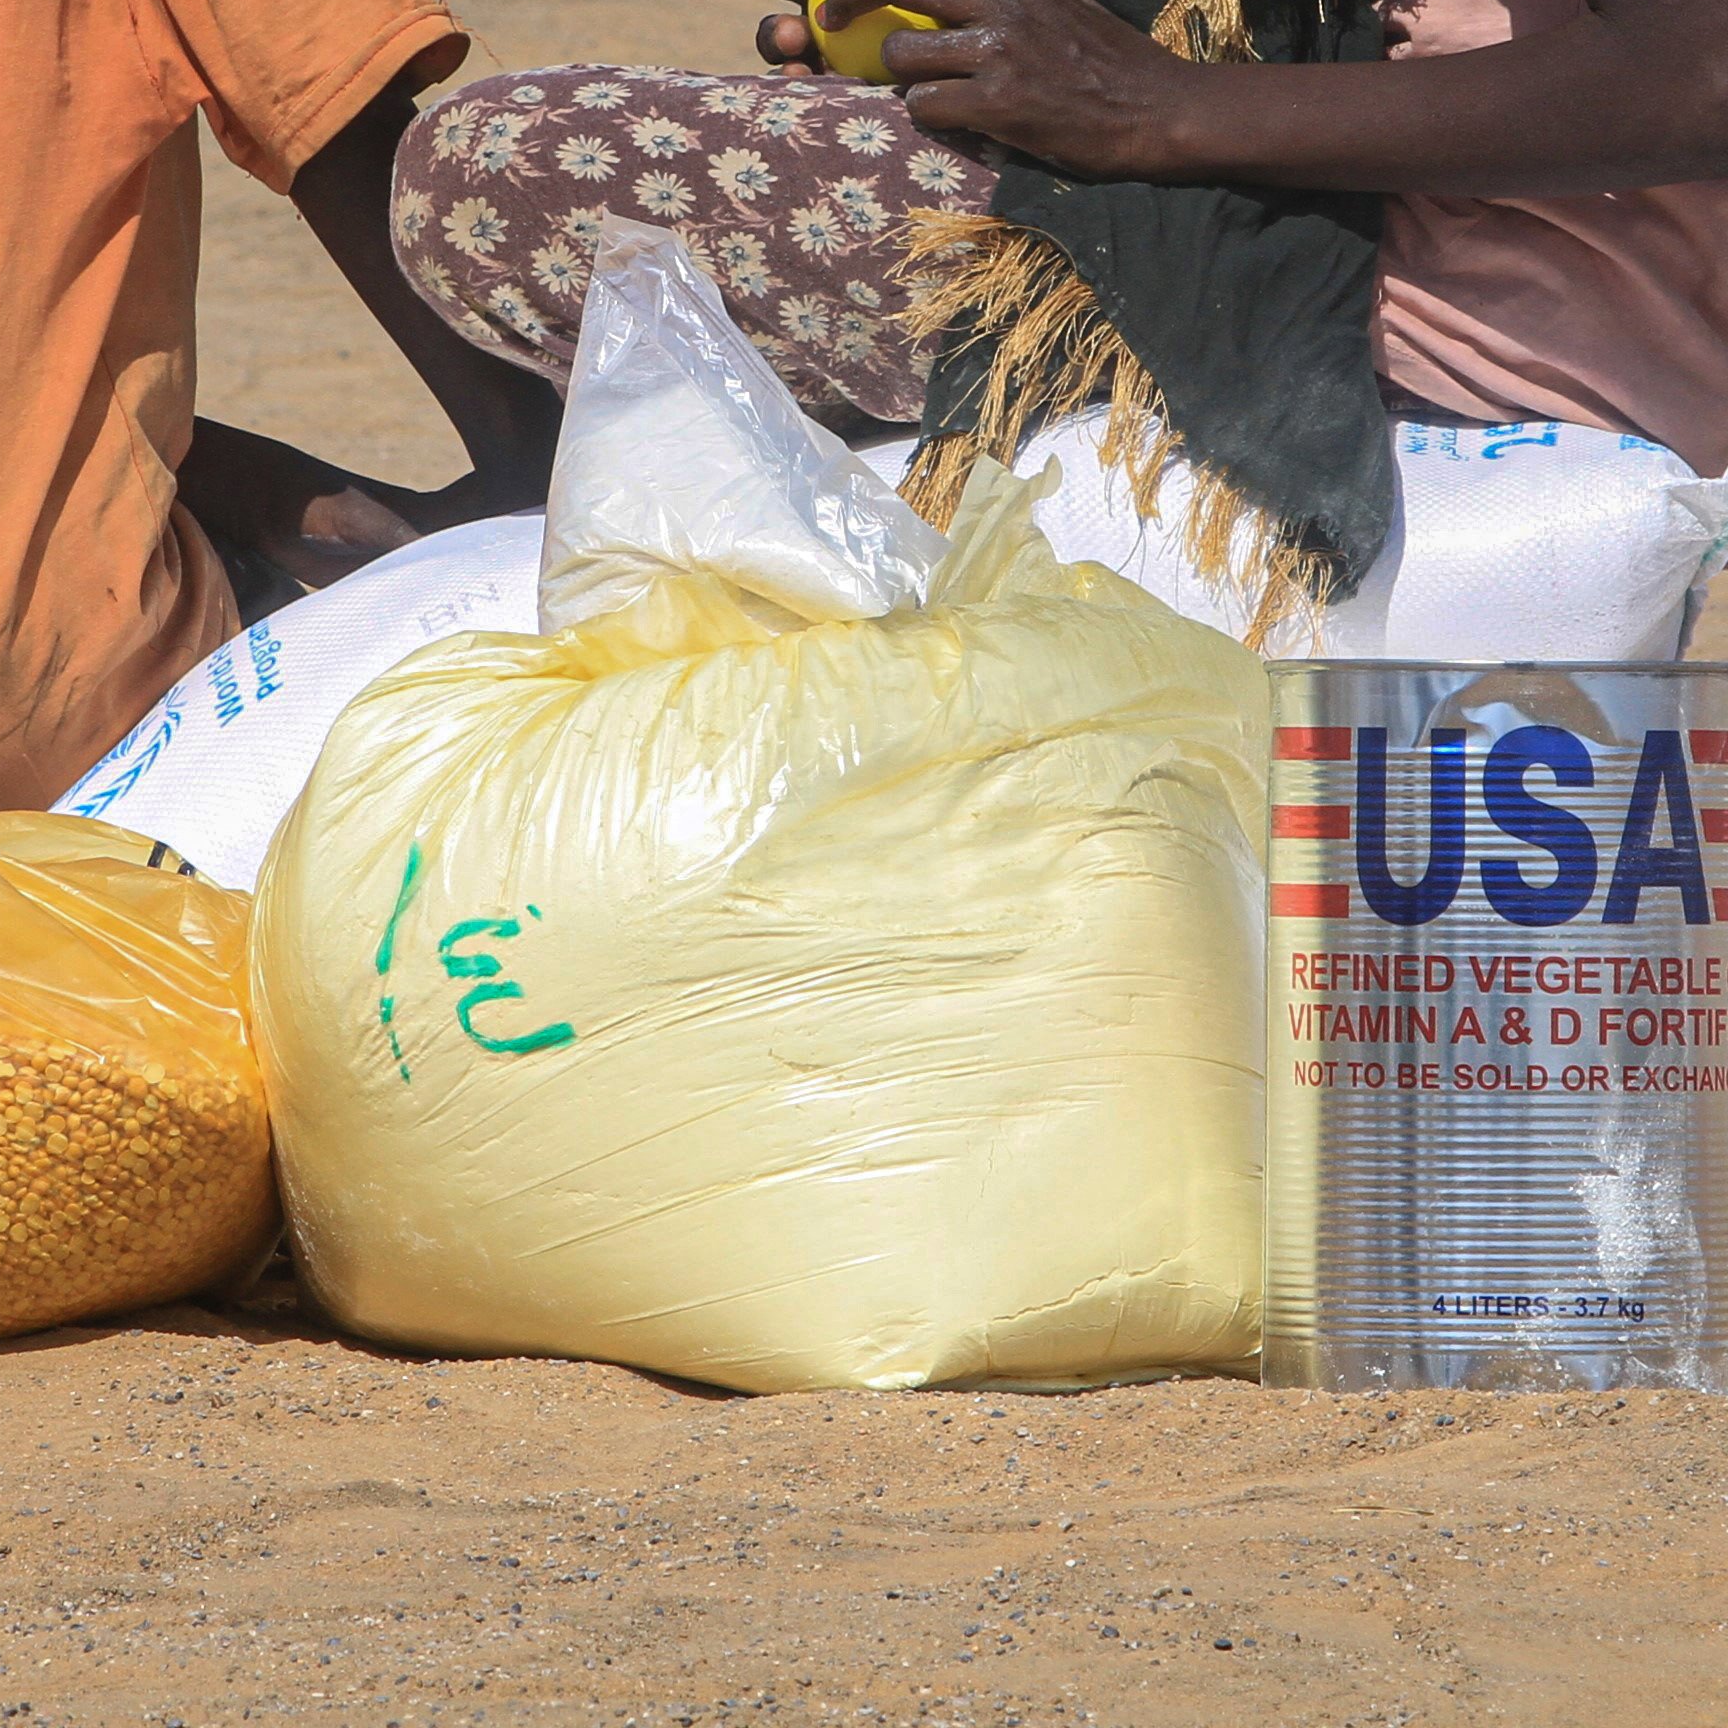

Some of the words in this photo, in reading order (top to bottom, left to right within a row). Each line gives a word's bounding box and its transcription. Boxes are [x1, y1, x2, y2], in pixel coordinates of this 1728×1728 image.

[206, 656, 244, 728] World
[1356, 725, 1711, 927] USA
[1291, 952, 1455, 993] REFINED
[1469, 955, 1721, 996] VEGETABLE
[1288, 1003, 1437, 1044] VITAMIN
[1450, 1006, 1486, 1045] A
[1499, 1006, 1533, 1046] &
[1550, 1007, 1581, 1046] D
[1294, 1060, 1338, 1088] NOT
[1347, 1061, 1386, 1089] TO
[1397, 1063, 1440, 1090] BE
[1453, 1063, 1549, 1092] SOLD
[1561, 1064, 1611, 1092] OR
[1432, 1294, 1447, 1316] 4
[1455, 1295, 1549, 1317] LITERS
[1574, 1295, 1610, 1318] 3.7
[1617, 1296, 1645, 1323] kg
